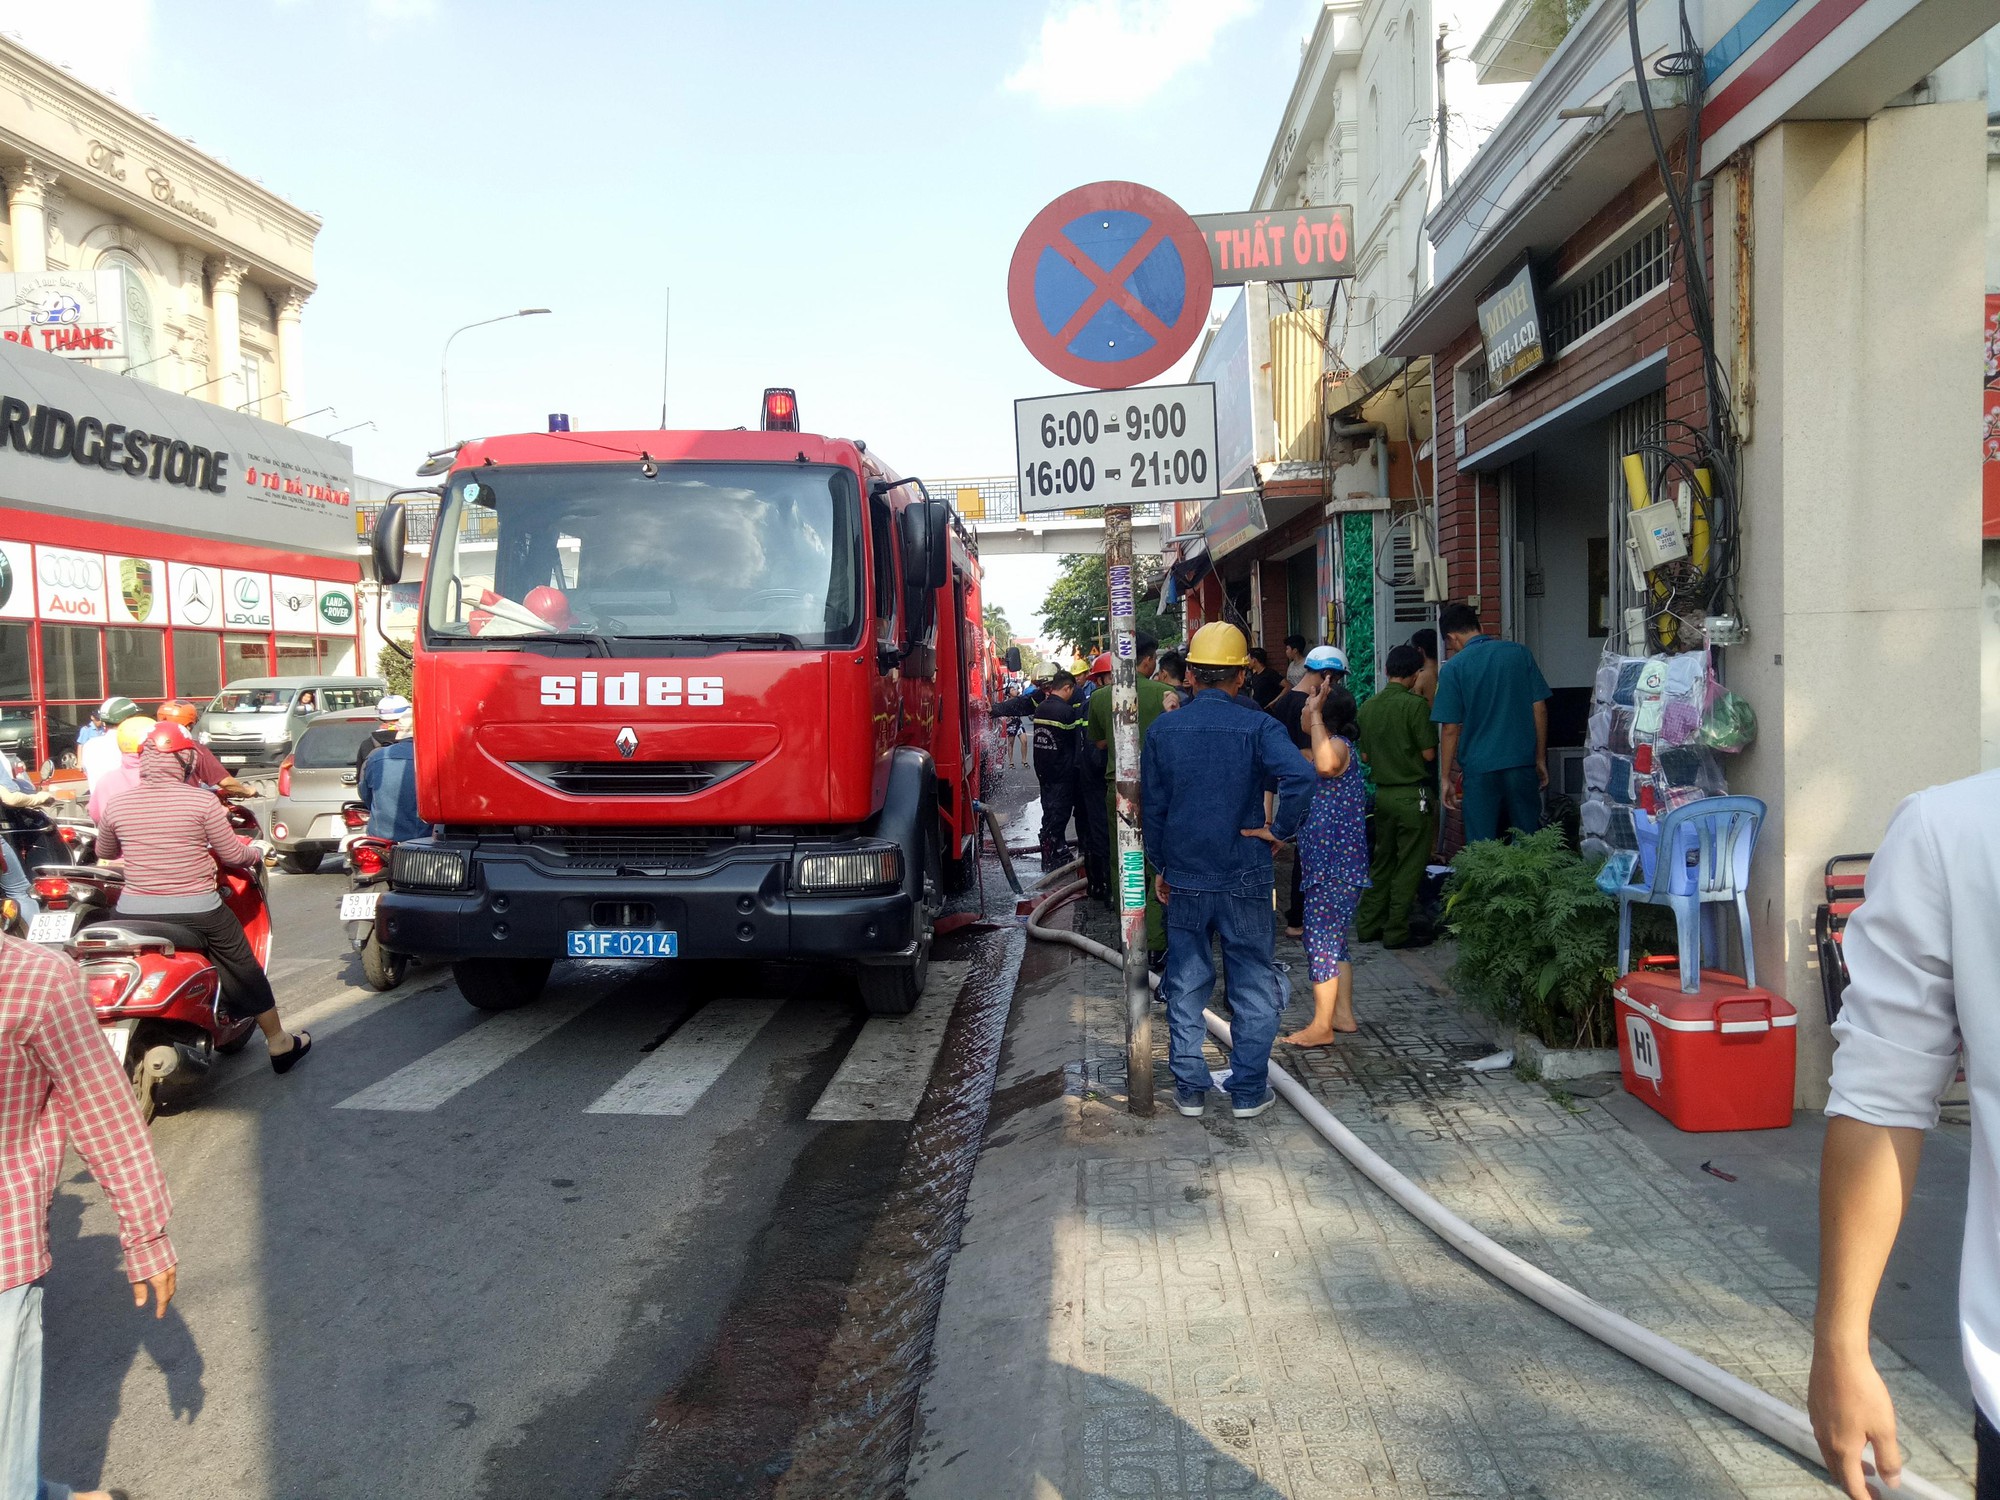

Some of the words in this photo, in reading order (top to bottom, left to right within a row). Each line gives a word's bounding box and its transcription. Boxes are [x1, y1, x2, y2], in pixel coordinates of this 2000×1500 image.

[1215, 216, 1285, 270] THẤT
[1293, 213, 1347, 265] ÔTÔ
[1486, 282, 1529, 339] MINH
[1488, 320, 1536, 373] TIVI-LCD
[1041, 409, 1099, 448] 6:00
[1126, 402, 1186, 441] 9:00
[0, 395, 229, 494] RIDGESTONE
[261, 471, 280, 490] TÔ
[1026, 456, 1095, 496] 16:00
[1130, 448, 1207, 488] 21:00
[49, 594, 95, 616] Audi
[226, 613, 270, 625] LEXUS
[326, 597, 343, 607] LAND
[327, 607, 349, 618] ROVER
[541, 671, 724, 706] sides
[574, 933, 671, 955] 51F-0214
[1634, 1027, 1653, 1067] Hi
